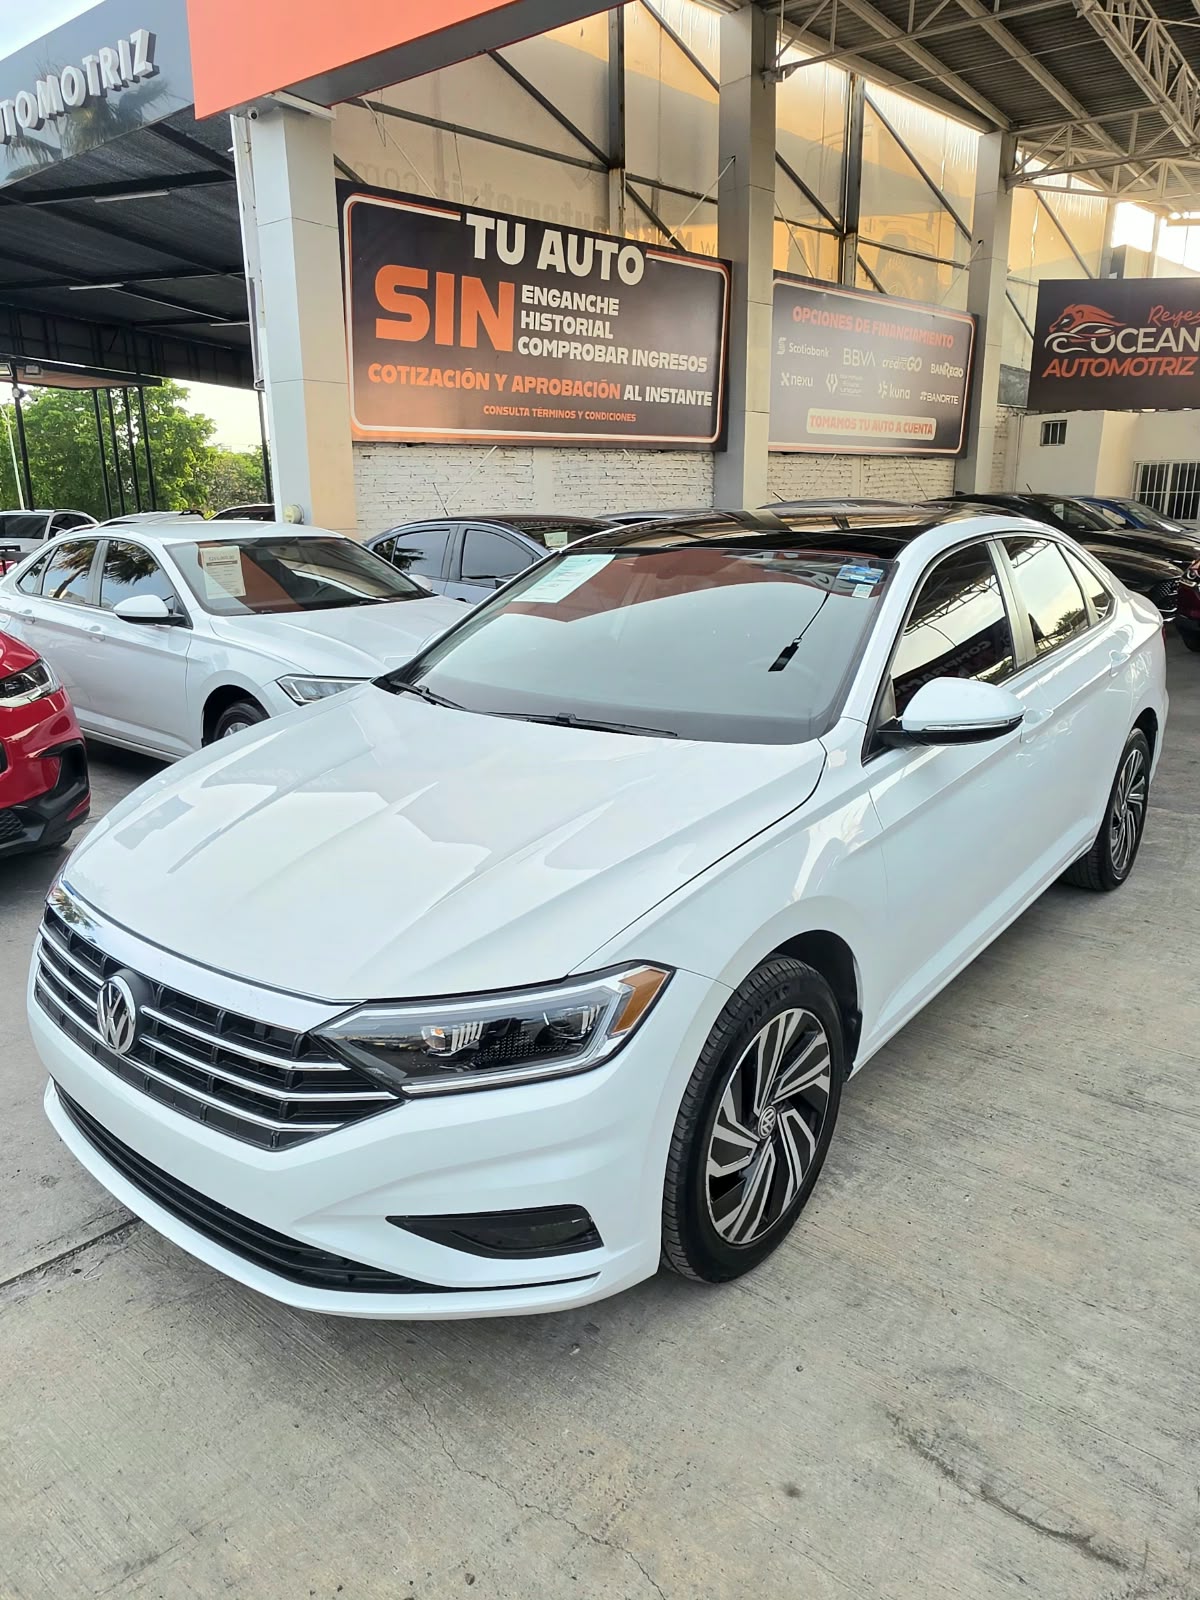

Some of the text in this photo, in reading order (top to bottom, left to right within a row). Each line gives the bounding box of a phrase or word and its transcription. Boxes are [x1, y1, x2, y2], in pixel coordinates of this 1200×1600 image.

[0, 29, 155, 144] TOMOTRIZ
[465, 213, 645, 286] TU AUTO
[374, 264, 515, 352] SIN
[521, 284, 620, 316] ENGANCHE
[520, 310, 614, 340] HISTORIAL
[792, 305, 955, 349] OPCIONES DE FINANCIAMIENTO
[517, 336, 708, 373] COMPROBAR INGRESOS
[788, 342, 830, 358] Scotiabank
[843, 347, 876, 367] BBVA
[1041, 356, 1199, 378] AUTOMOTRIZ
[368, 363, 713, 407] COTIZACIÓN Y APROBACIÓN AL INSTANTE
[791, 375, 814, 387] nexu
[889, 383, 911, 400] kuna
[926, 392, 959, 405] BANORTE
[483, 405, 636, 422] CONSULTA TÉRMINOS Y CONDICIONES
[810, 415, 933, 435] TOMAMOS TU AUTO A CUENTA
